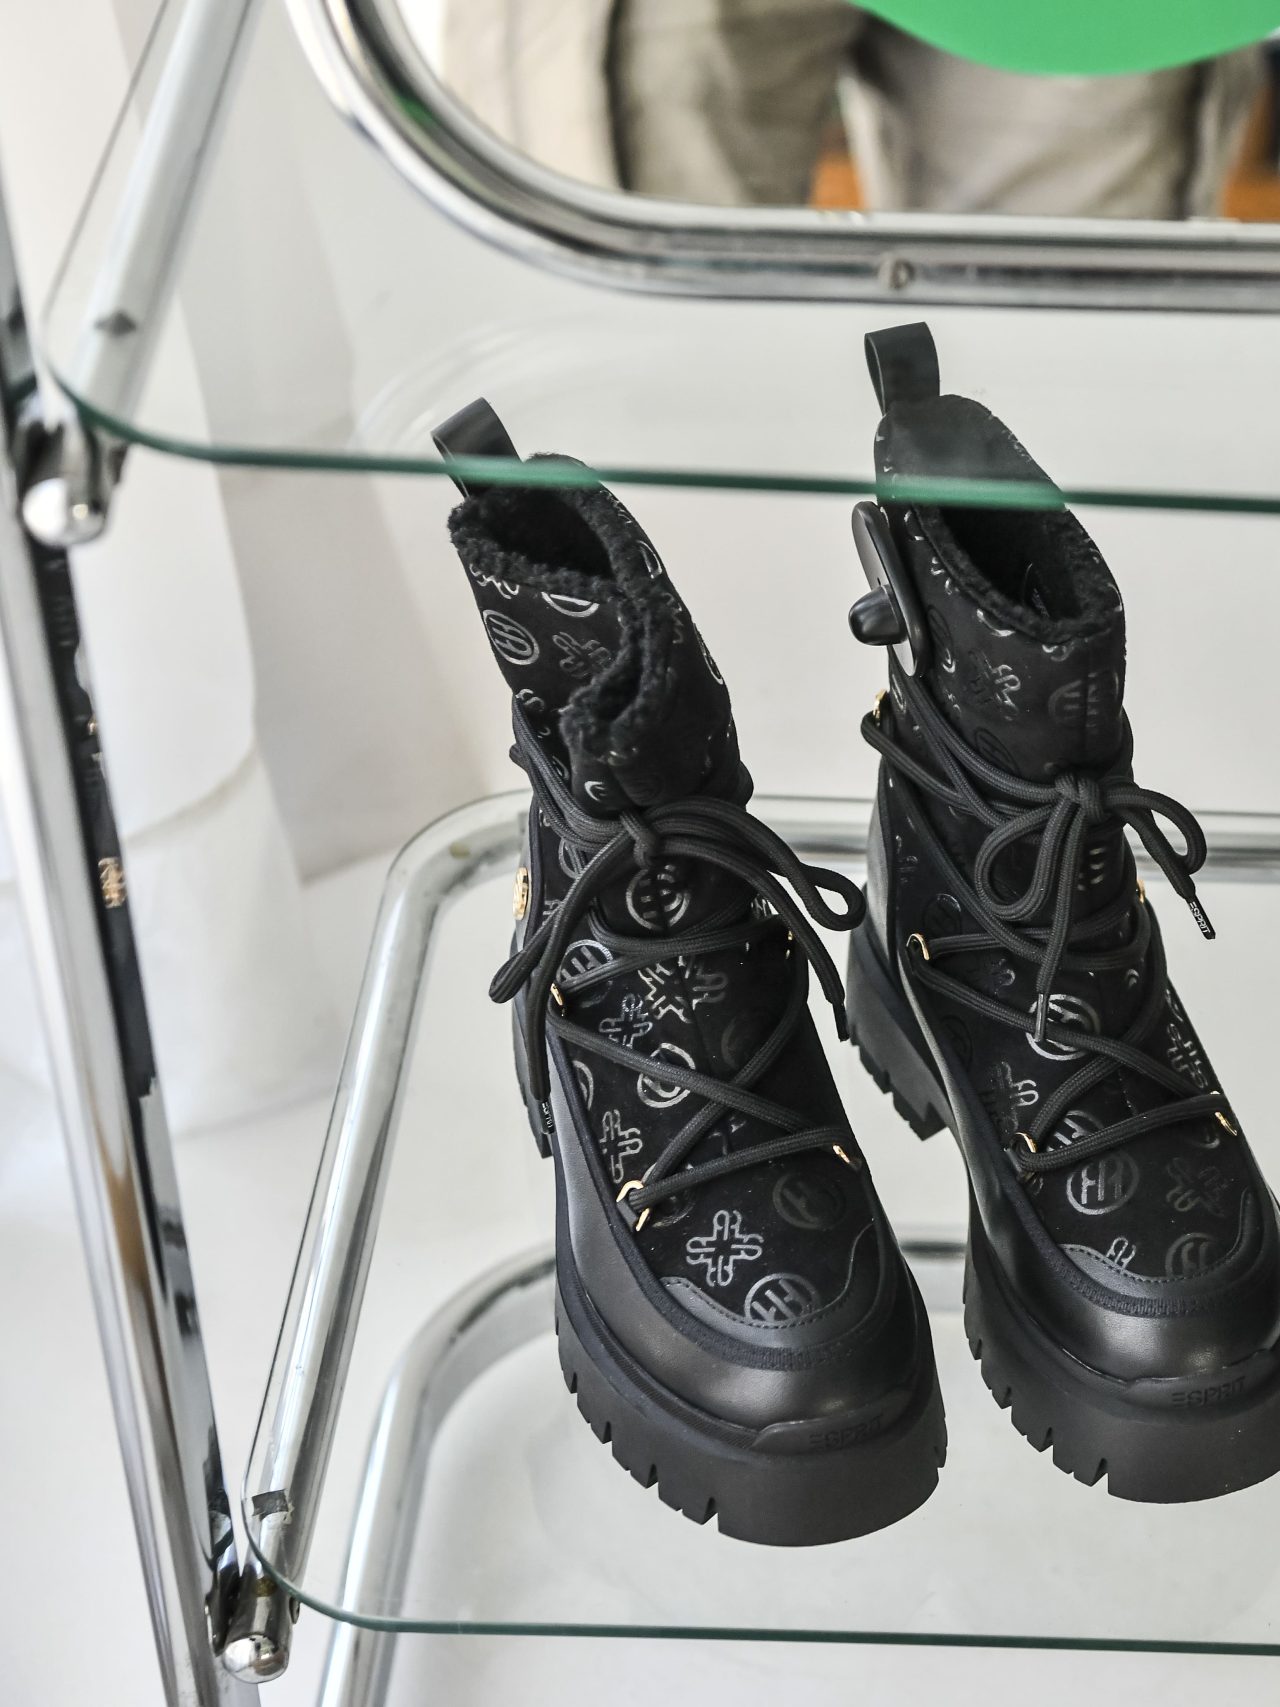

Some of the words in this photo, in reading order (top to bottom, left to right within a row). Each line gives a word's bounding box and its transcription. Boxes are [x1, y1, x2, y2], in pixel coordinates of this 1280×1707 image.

[1189, 901, 1211, 933] ESPRIT
[1172, 1375, 1246, 1408] ESPRIT
[809, 1414, 883, 1452] ESPRIT
